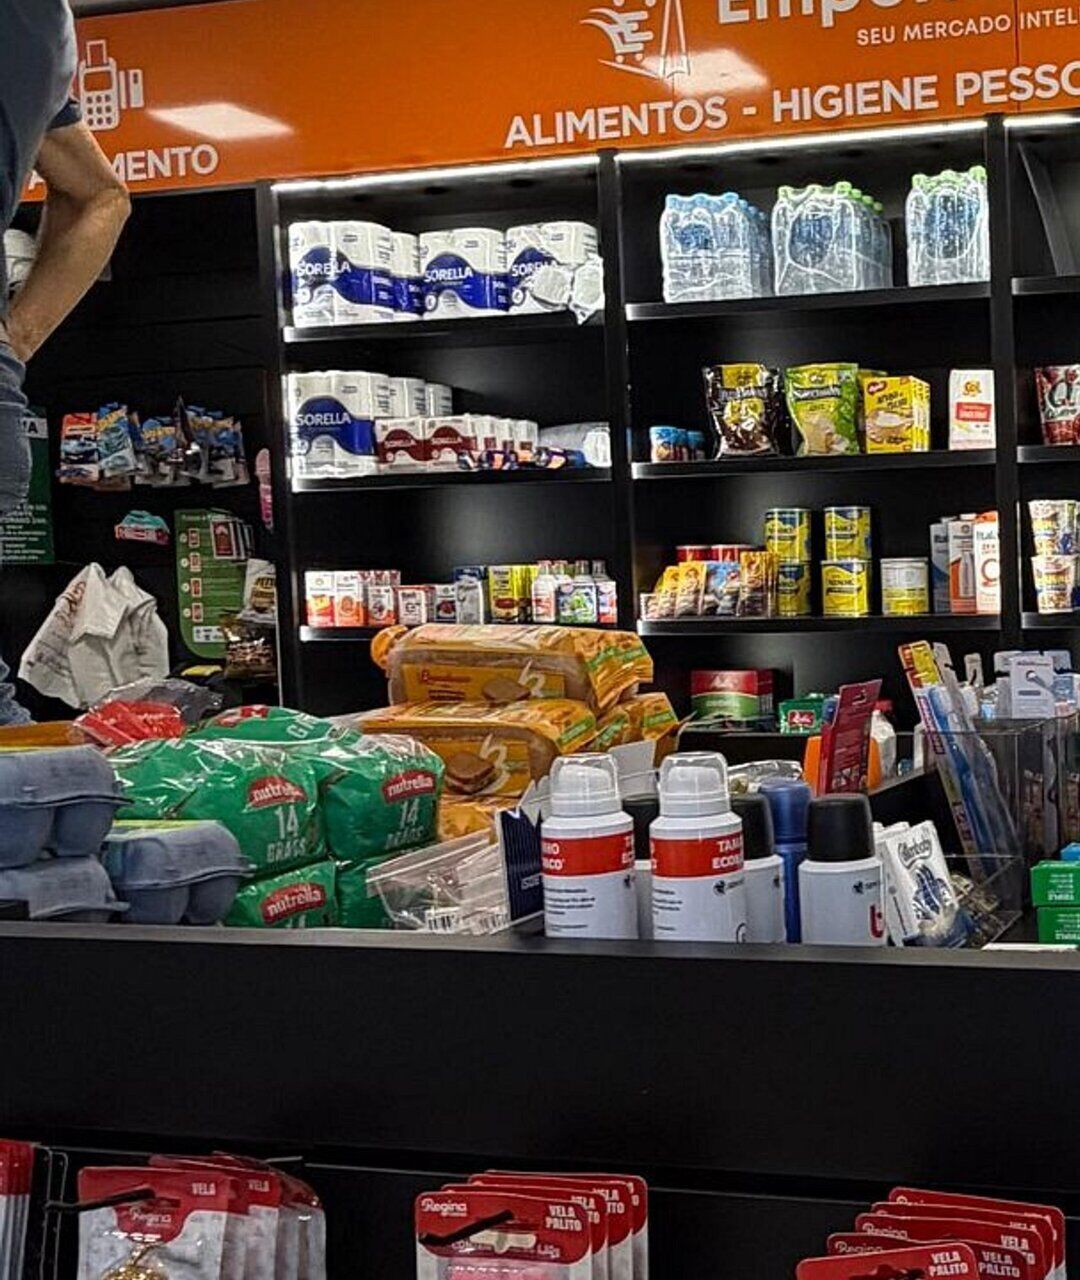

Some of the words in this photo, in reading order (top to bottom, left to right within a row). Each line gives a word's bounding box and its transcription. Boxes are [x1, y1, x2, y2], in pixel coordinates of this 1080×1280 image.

[857, 26, 895, 46] SEU
[902, 15, 1012, 43] MERCADO
[505, 96, 728, 148] ALIMENTOS
[773, 75, 939, 123] HIGIENE
[424, 265, 473, 283] SORELLA
[297, 412, 352, 426] SORELLA
[387, 775, 435, 797] nutrella
[400, 798, 421, 829] 14
[274, 805, 300, 840] 14
[266, 888, 323, 917] nutrella
[191, 1181, 216, 1196] VELA
[421, 1198, 468, 1214] Regina
[548, 1204, 576, 1218] VELA
[545, 1217, 583, 1232] PALITO
[930, 1251, 961, 1265] VELA
[981, 1250, 1013, 1265] VELA
[928, 1262, 969, 1277] PALITO
[977, 1261, 1021, 1278] PALITO
